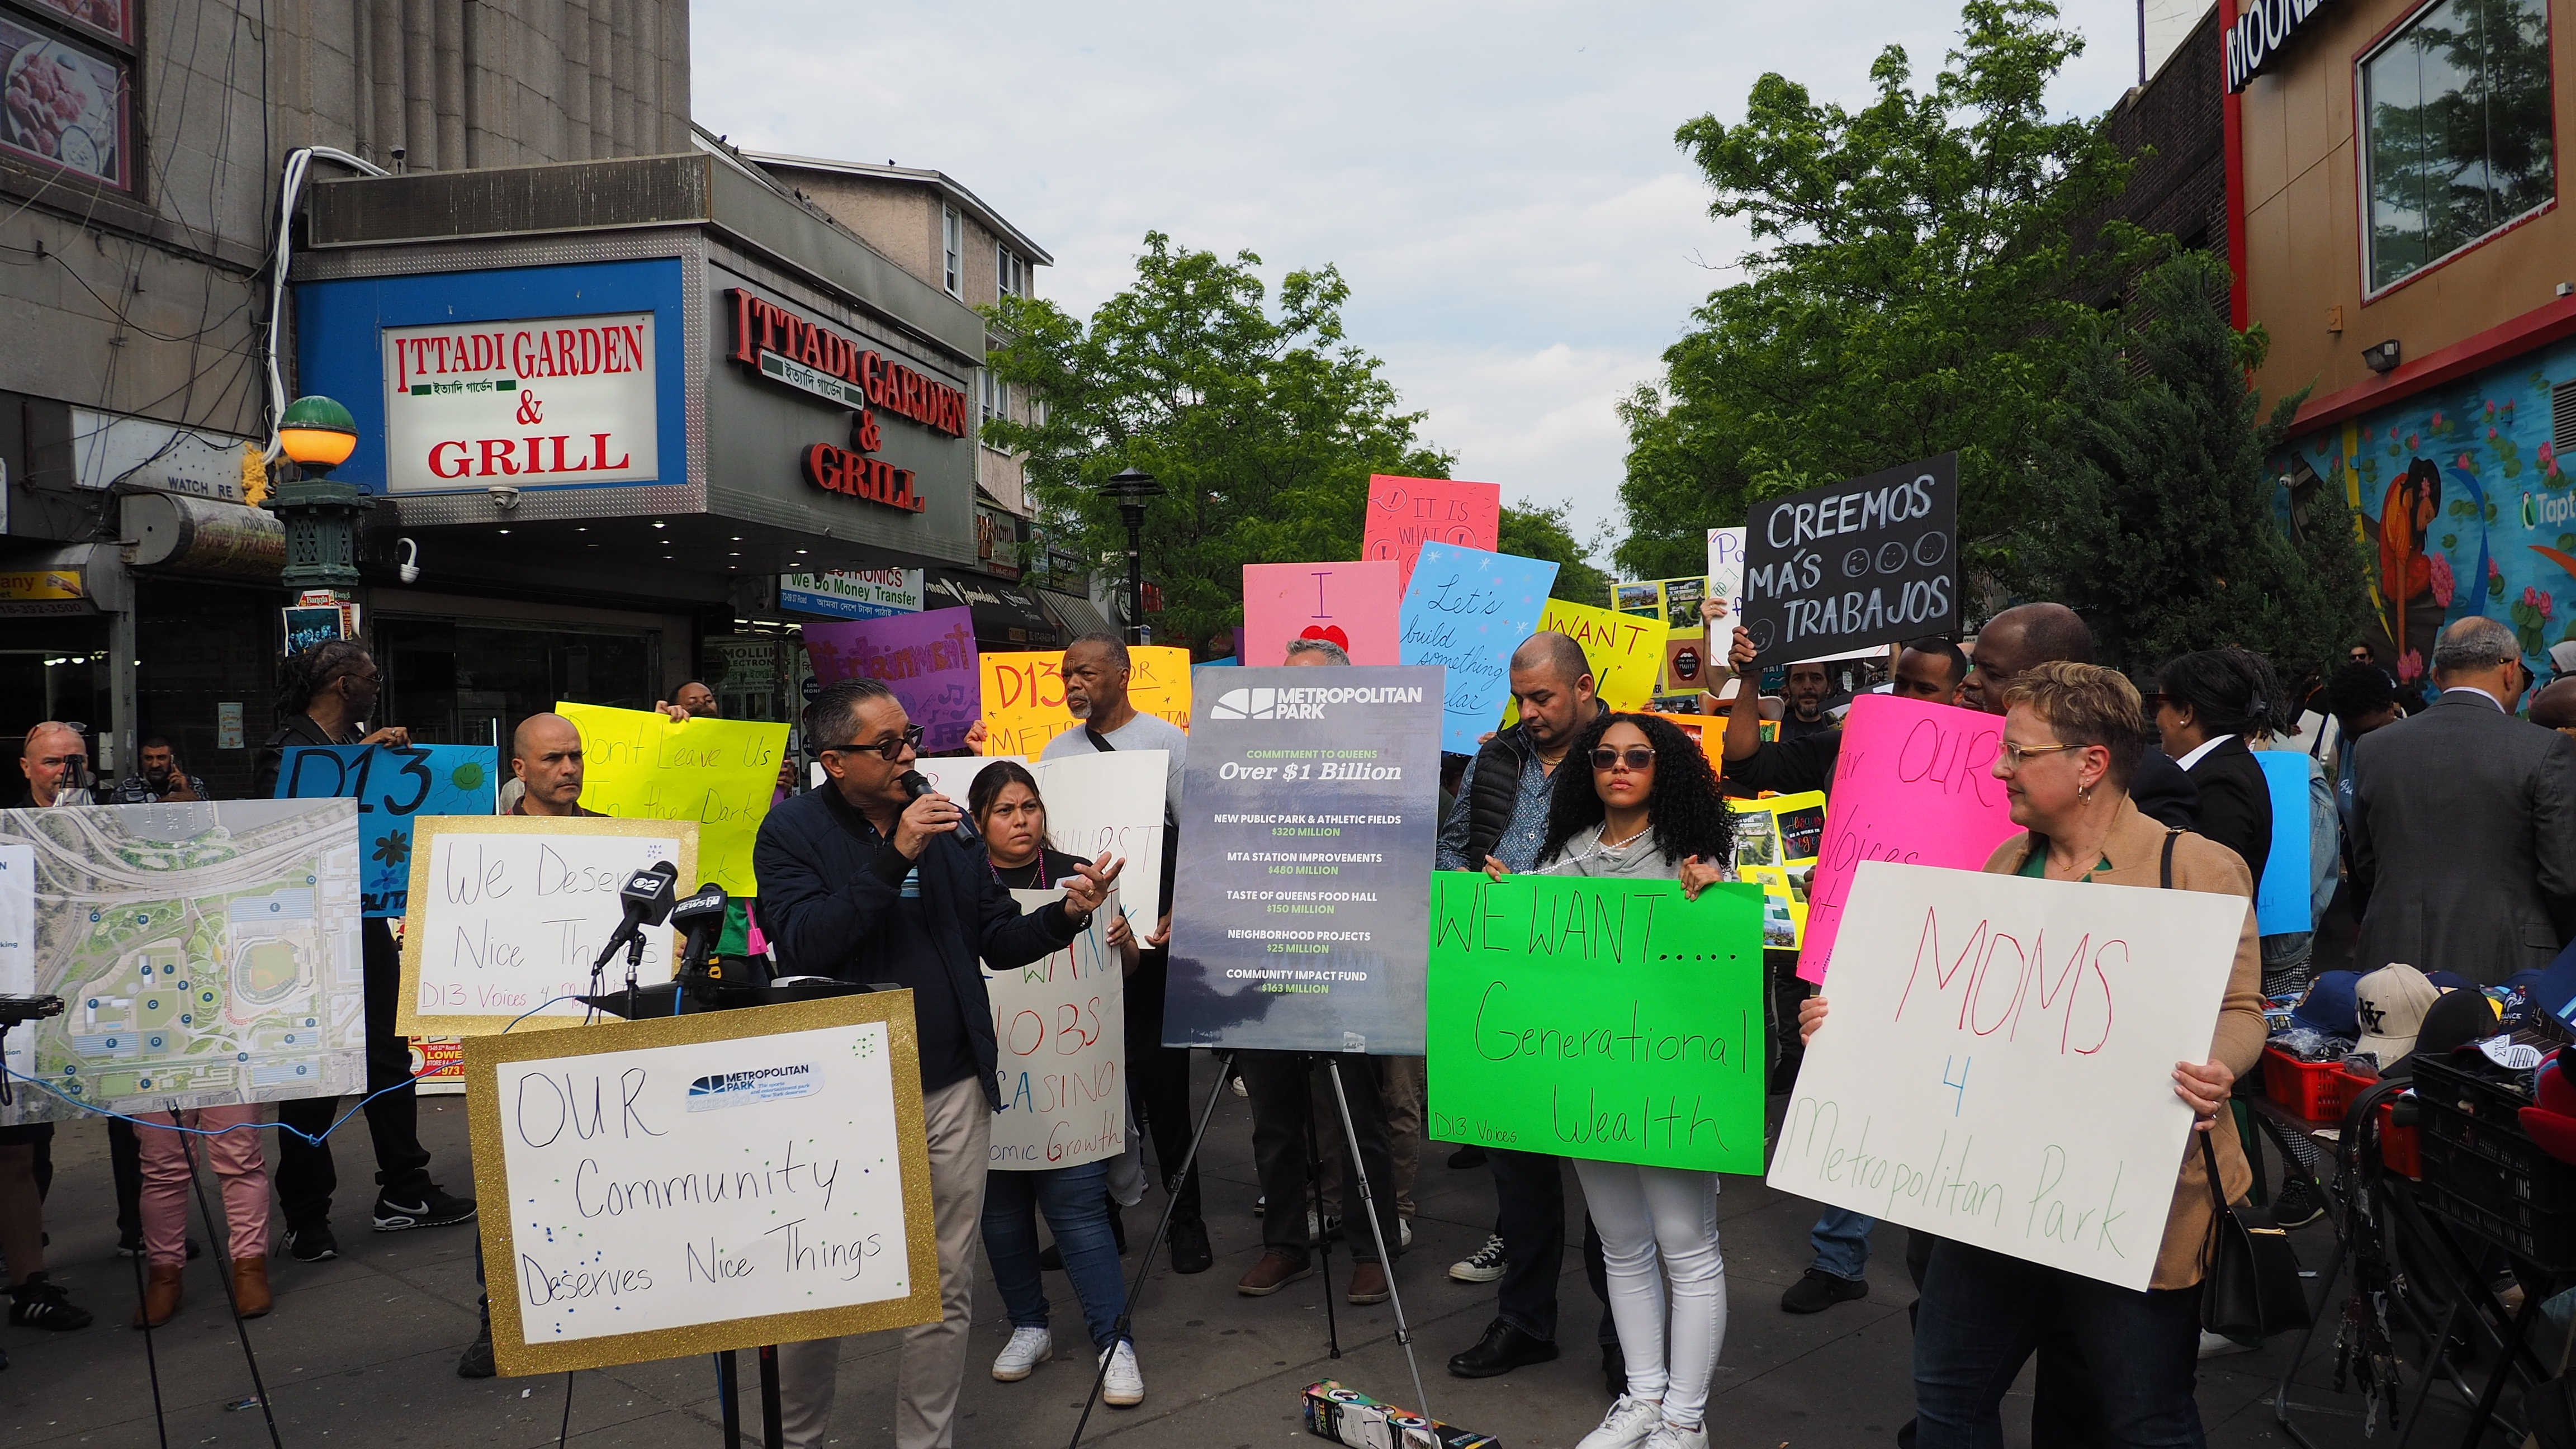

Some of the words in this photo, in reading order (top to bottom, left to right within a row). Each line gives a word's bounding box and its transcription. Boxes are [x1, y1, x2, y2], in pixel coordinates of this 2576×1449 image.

[396, 333, 506, 392] ITTADI
[513, 325, 643, 380] GARDEN
[725, 287, 858, 385] ITTADI
[857, 350, 967, 439] GARDEN
[516, 389, 543, 425] &
[856, 409, 882, 453] &
[428, 433, 629, 479] GRILL
[168, 476, 209, 495] WATCH
[807, 442, 925, 514] GRILL
[1413, 496, 1437, 518] IT
[1444, 499, 1469, 522] IS
[1767, 473, 1935, 549] CREEMOS
[792, 572, 810, 588] We
[834, 578, 870, 602] Money
[875, 585, 917, 606] Transfer
[1310, 571, 1333, 618] I
[1427, 574, 1504, 615] Let's
[1747, 548, 1822, 602] MÁS
[1783, 575, 1950, 643] TRABAJOS
[1399, 614, 1458, 649] build
[1548, 612, 1649, 655] WANT
[1417, 646, 1510, 693] something
[1276, 687, 1423, 704] METROPOLITAN
[1276, 703, 1325, 720] PARK
[657, 724, 721, 769] Leave
[743, 735, 771, 768] Us
[1246, 749, 1319, 759] COMMITMENT
[1320, 750, 1335, 759] TO
[1337, 750, 1377, 760] QUEENS
[1898, 718, 2000, 807] OUR
[287, 744, 433, 816] D13
[1219, 761, 1278, 780] Over
[1282, 762, 1311, 783] $1
[1318, 762, 1401, 782] Billion
[643, 785, 678, 821] the
[700, 788, 756, 824] Dark
[1214, 814, 1240, 824] NEW
[1240, 814, 1276, 824] PUBLIC
[1278, 815, 1306, 824] PARK
[1308, 815, 1316, 824] &
[1317, 815, 1366, 825] ATHLETIC
[1367, 815, 1401, 825] FIELDS
[1272, 827, 1296, 837] $320
[1298, 828, 1341, 837] MILLION
[446, 842, 513, 905] We
[538, 842, 631, 897] Deser
[1227, 852, 1251, 861] MTA
[1252, 853, 1298, 862] STATION
[1299, 853, 1383, 863] IMPROVEMENTS
[1268, 865, 1294, 875] $480
[1295, 866, 1339, 875] MILLION
[675, 899, 707, 913] NEWS
[1227, 891, 1258, 901] TASTE
[1259, 891, 1273, 901] OF
[1275, 891, 1317, 902] QUEENS
[1318, 892, 1349, 902] FOOD
[1351, 892, 1378, 902] HALL
[1266, 904, 1290, 914] $150
[1291, 905, 1335, 915] MILLION
[1227, 929, 1315, 940] NEIGHBORHOOD
[1317, 931, 1371, 941] PROJECTS
[1437, 880, 1510, 953] WE
[453, 918, 525, 969] Nice
[1266, 943, 1284, 954] $25
[1285, 944, 1329, 954] MILLION
[422, 982, 467, 1007] D13
[477, 983, 527, 1007] Voices
[1226, 969, 1294, 980] COMMUNITY
[1295, 970, 1337, 981] IMPACT
[1338, 971, 1367, 982] FUND
[1262, 983, 1284, 993] $163
[1285, 984, 1329, 994] MILLION
[1895, 906, 2129, 1055] MOMS
[1475, 981, 1746, 1073] Generational
[442, 1066, 460, 1075] 973
[726, 1064, 809, 1083] METROPOLITAN
[727, 1080, 755, 1092] PARK
[760, 1085, 798, 1095] entertainment
[798, 1082, 810, 1091] park
[1943, 1054, 1971, 1117] 4
[518, 1068, 669, 1148] OUR
[1554, 1084, 1729, 1152] Wealth
[1046, 1110, 1123, 1162] Growth
[1434, 1112, 1467, 1138] D13
[1476, 1119, 1518, 1144] Voices
[575, 1140, 840, 1219] Community
[1780, 1097, 2004, 1228] Metropolitan
[2026, 1144, 2127, 1259] Park
[522, 1253, 654, 1306] Deserves
[686, 1236, 755, 1285] Nice
[764, 1218, 882, 1282] Things
[1319, 1402, 1329, 1436] EASEL
